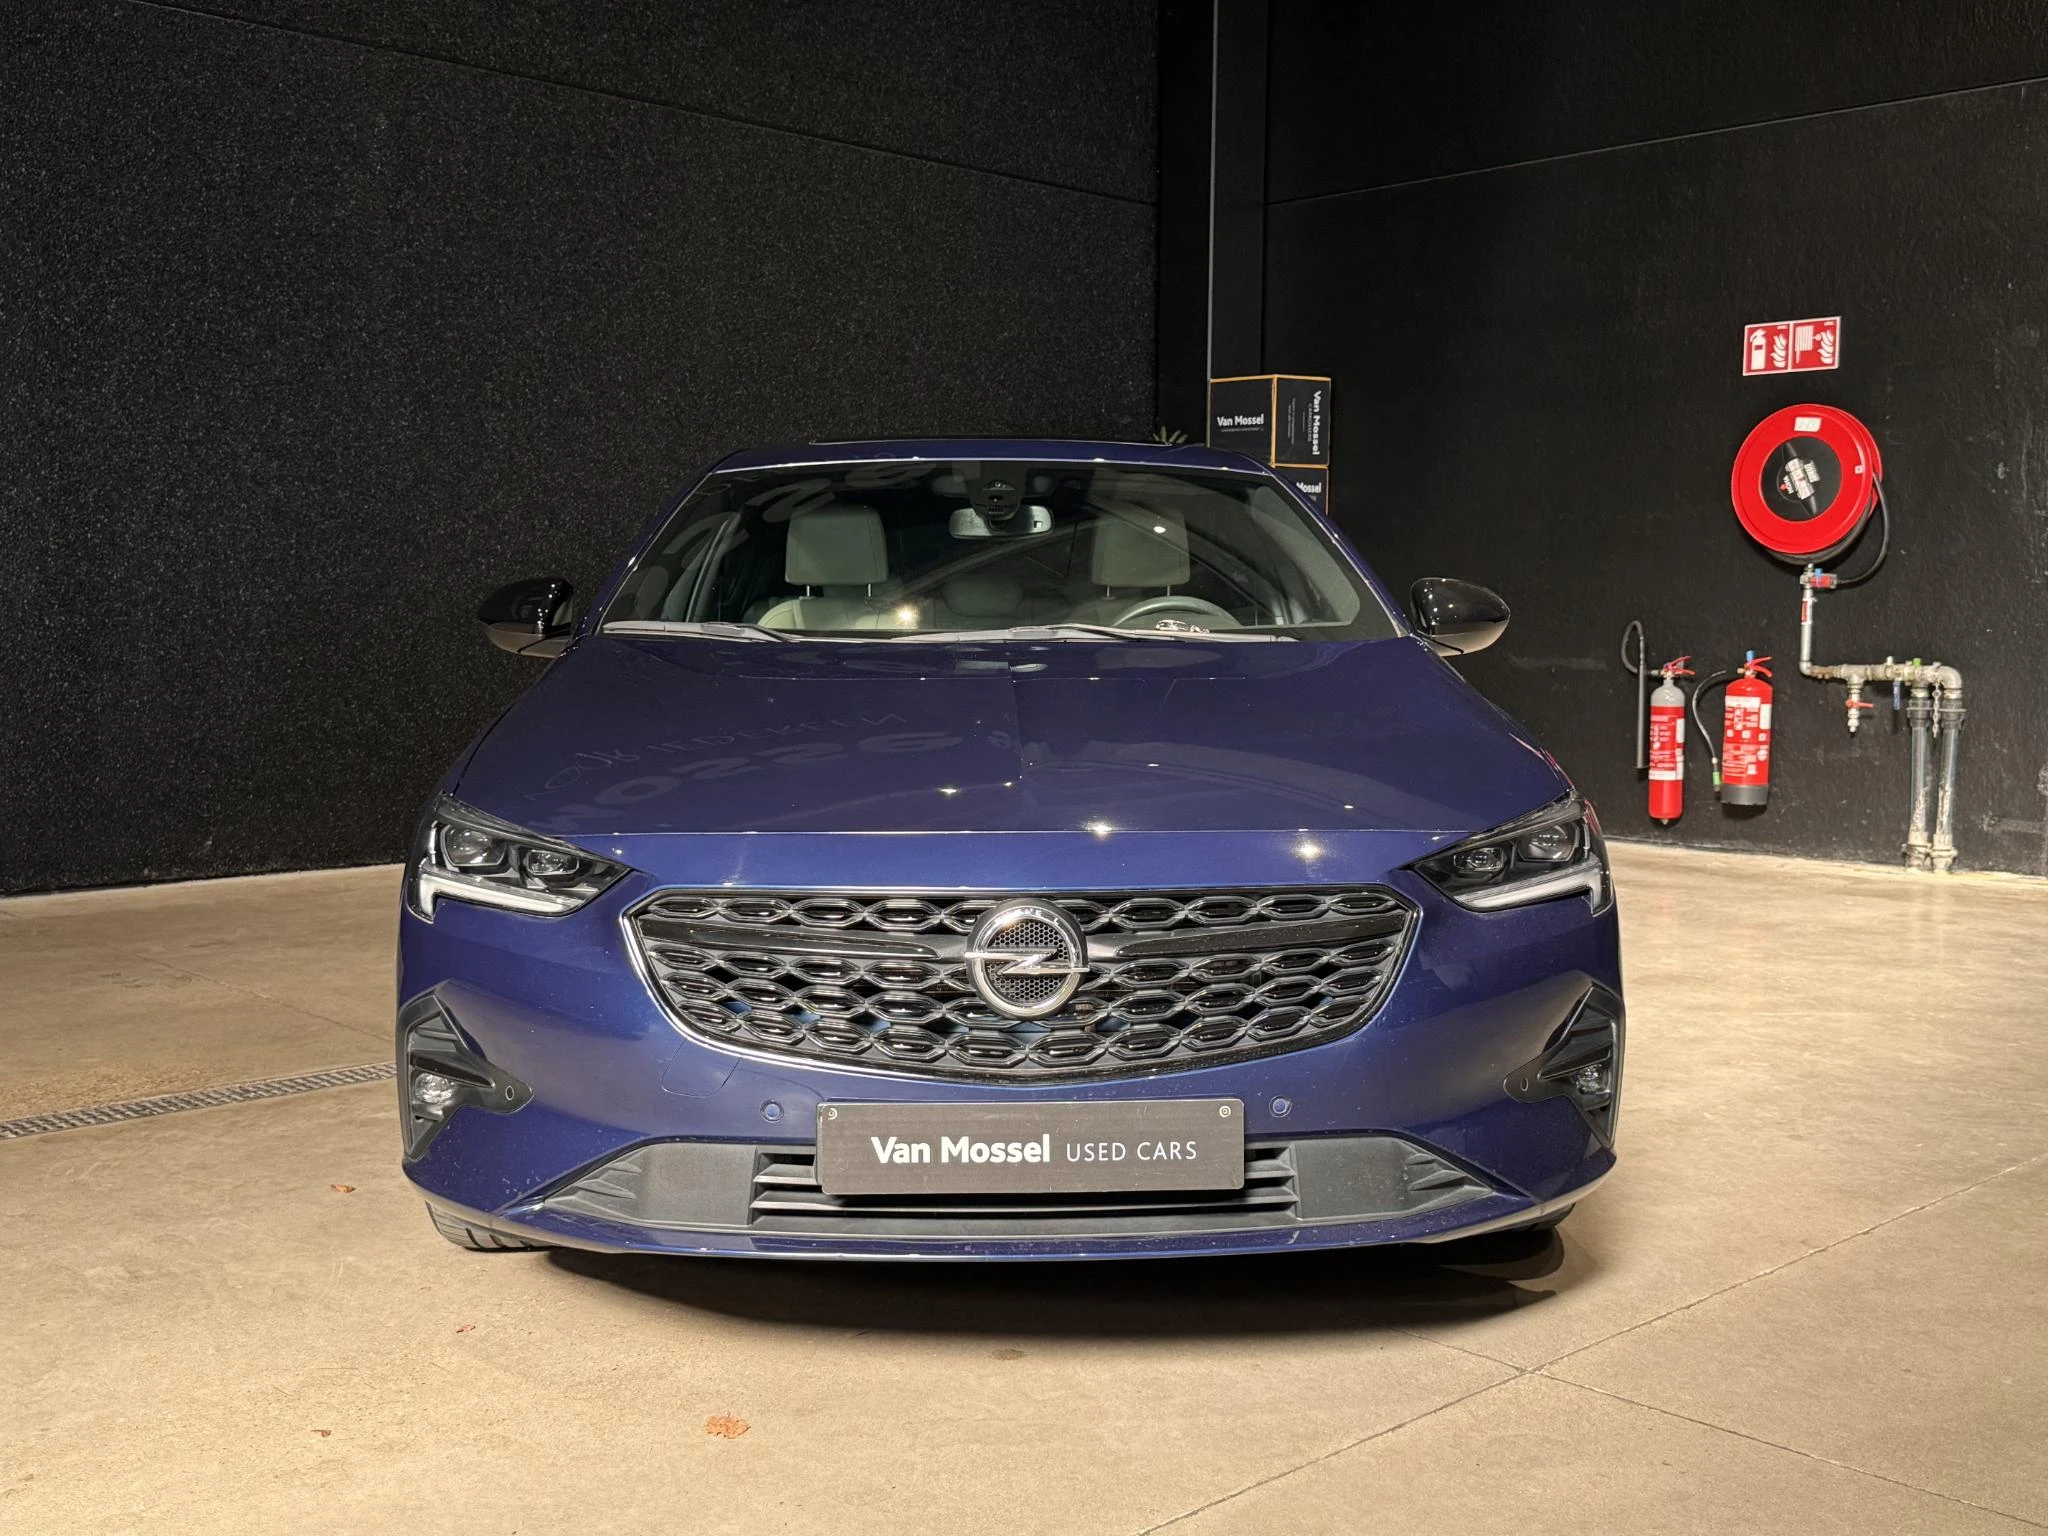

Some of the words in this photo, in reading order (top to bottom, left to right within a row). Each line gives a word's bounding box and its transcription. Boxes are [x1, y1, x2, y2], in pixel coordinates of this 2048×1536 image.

[1313, 390, 1322, 413] Van
[1216, 416, 1233, 427] Van
[1234, 413, 1264, 426] Mossel
[1312, 415, 1321, 456] Mossel
[870, 1136, 931, 1164] Van
[941, 1133, 1050, 1163] Mossel
[1066, 1142, 1127, 1162] USED
[1136, 1140, 1198, 1161] CARS
